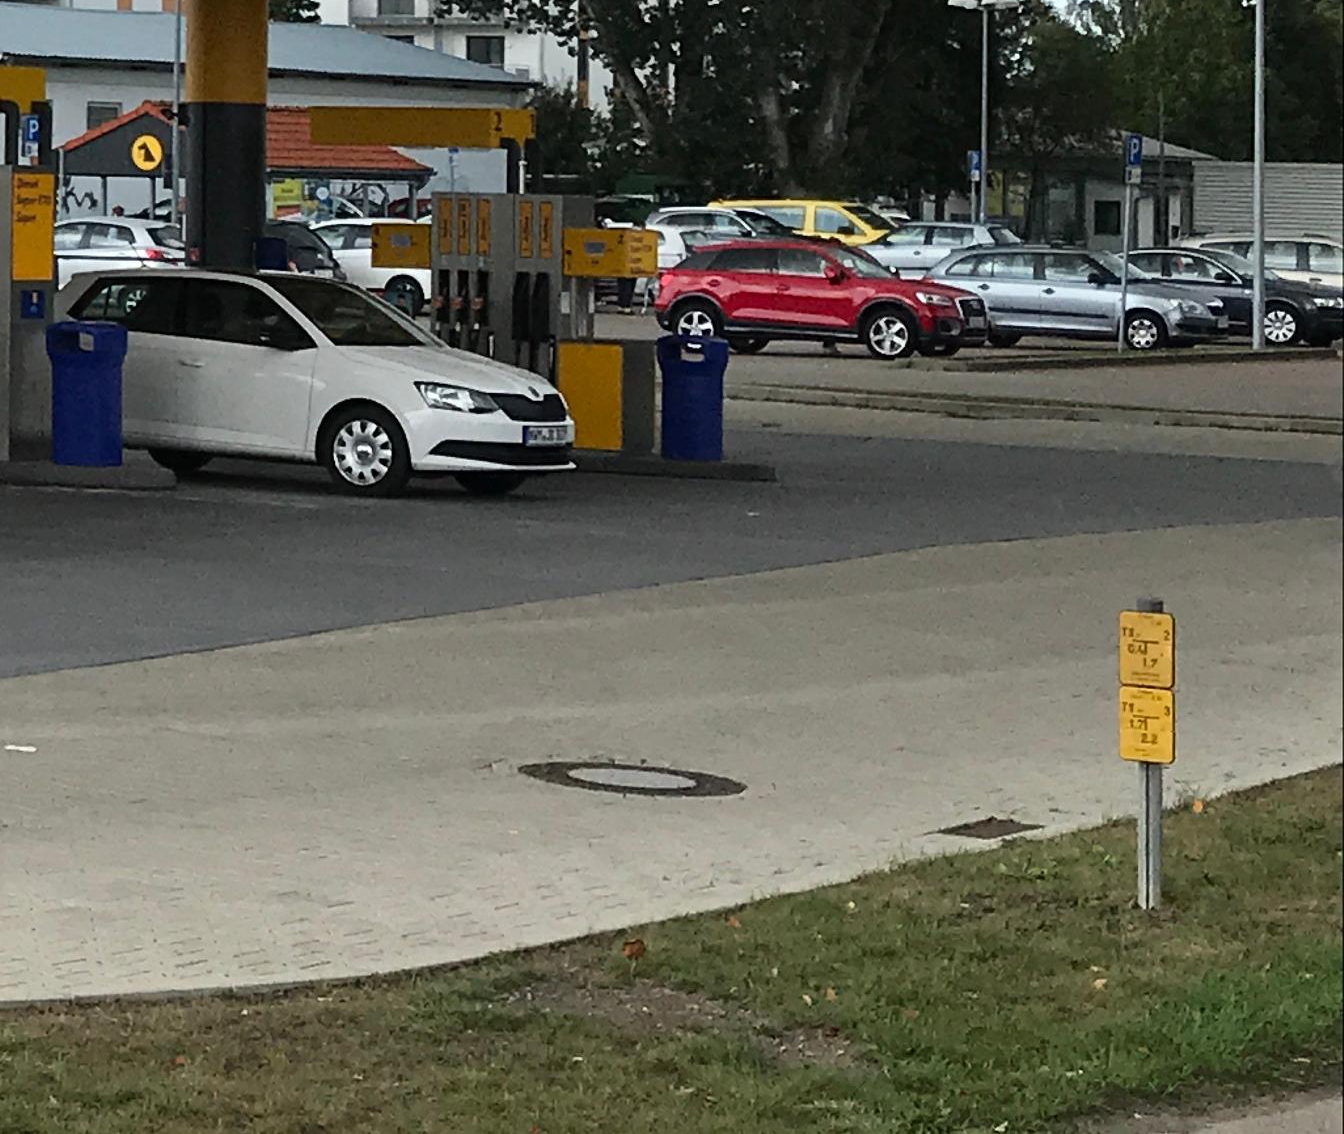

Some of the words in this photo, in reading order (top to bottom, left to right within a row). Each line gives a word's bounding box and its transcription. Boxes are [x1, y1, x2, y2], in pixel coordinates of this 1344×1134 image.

[29, 119, 40, 140] P
[1130, 138, 1140, 162] P
[1163, 629, 1170, 641] 2
[1164, 705, 1171, 716] 3
